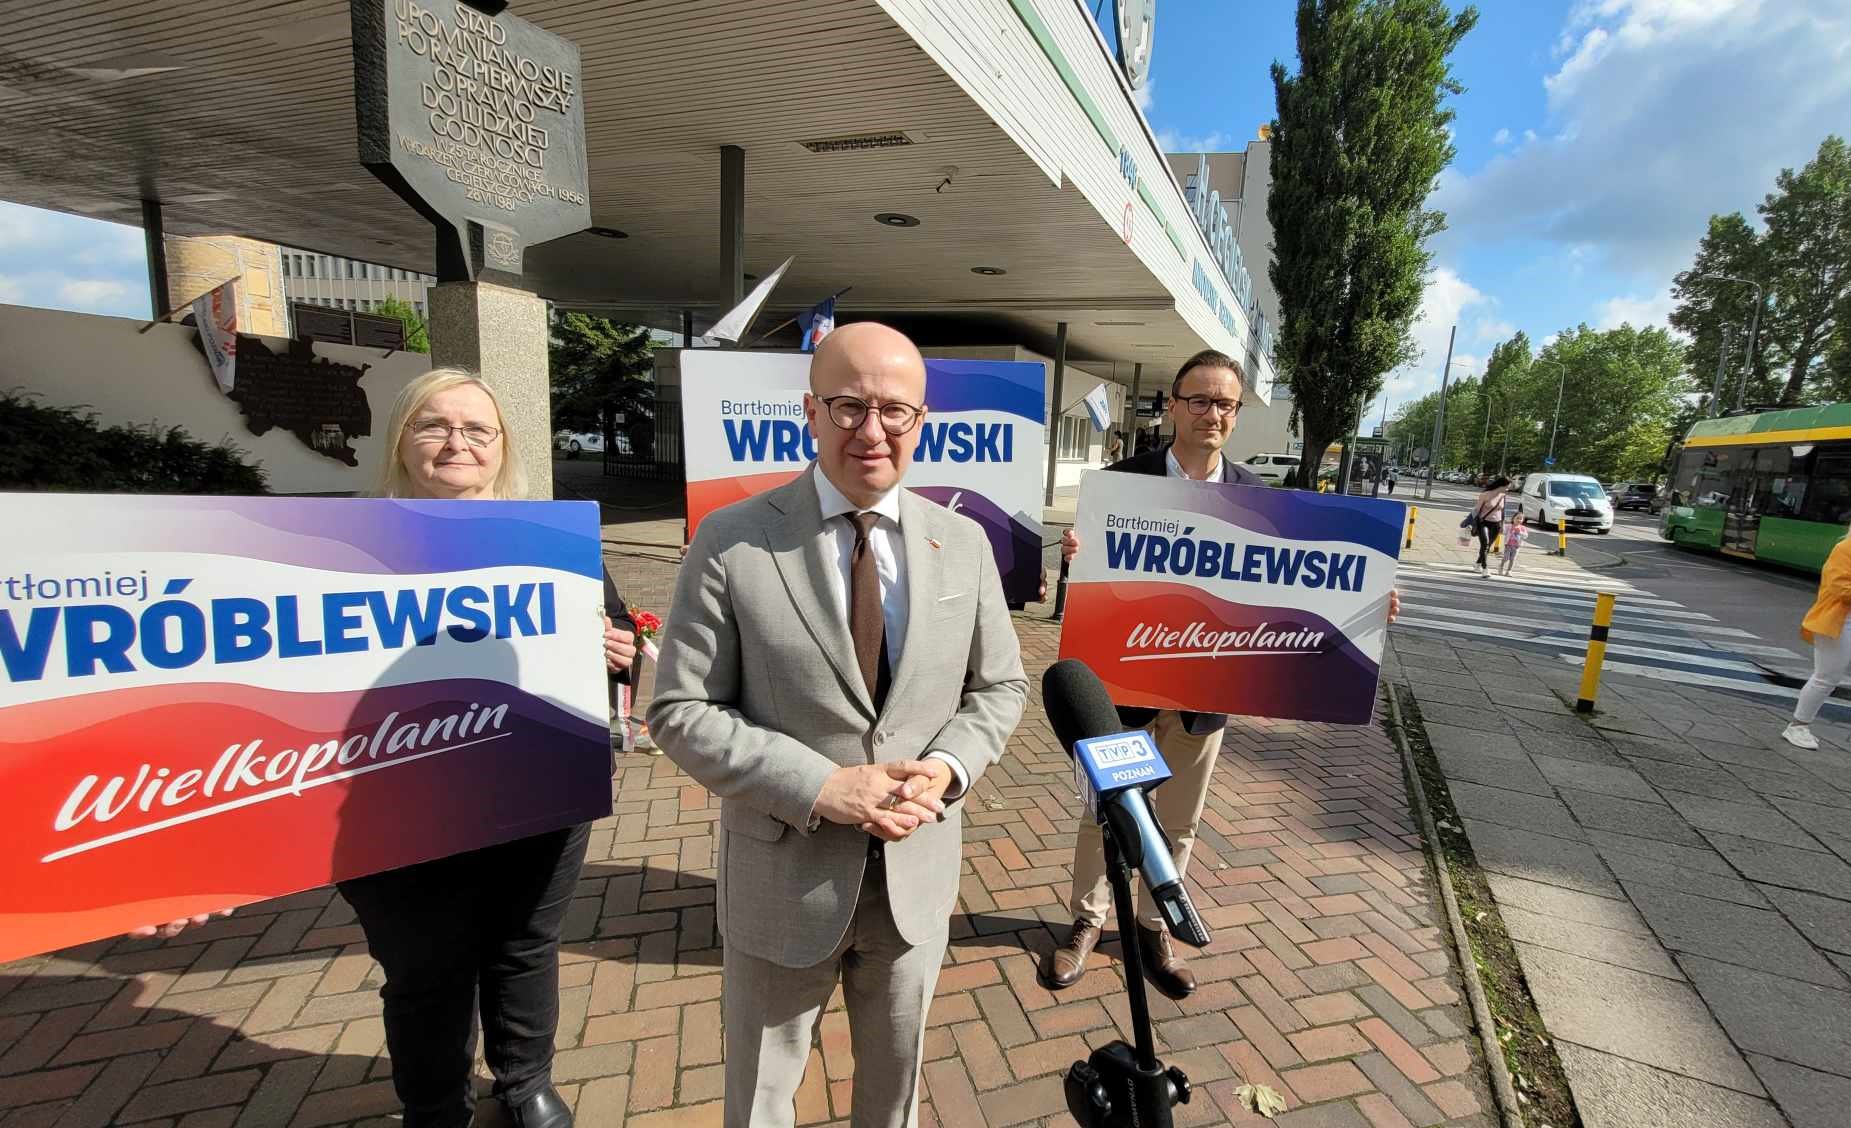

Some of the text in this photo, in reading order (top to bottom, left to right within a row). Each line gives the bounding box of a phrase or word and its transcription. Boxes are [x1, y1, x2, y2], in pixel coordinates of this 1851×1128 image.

[395, 0, 539, 81] UPOMNIANO
[398, 20, 572, 114] PO RAZ PIERWSZY
[434, 66, 534, 122] O PRAWO
[421, 82, 548, 149] DO LUDZKIEJ
[558, 185, 585, 206] 1956
[720, 399, 807, 419] Bartłomiej
[721, 418, 1014, 463] WRWSKI
[1106, 514, 1180, 536] Bartłomiej
[1105, 526, 1368, 593] WRÓBLEWSKI
[0, 570, 149, 602] tłomiej
[1125, 621, 1326, 659] Wielkopolanin
[53, 702, 510, 832] Wielkopolanin
[1132, 739, 1148, 758] 3
[1112, 764, 1155, 783] POZNAŃ
